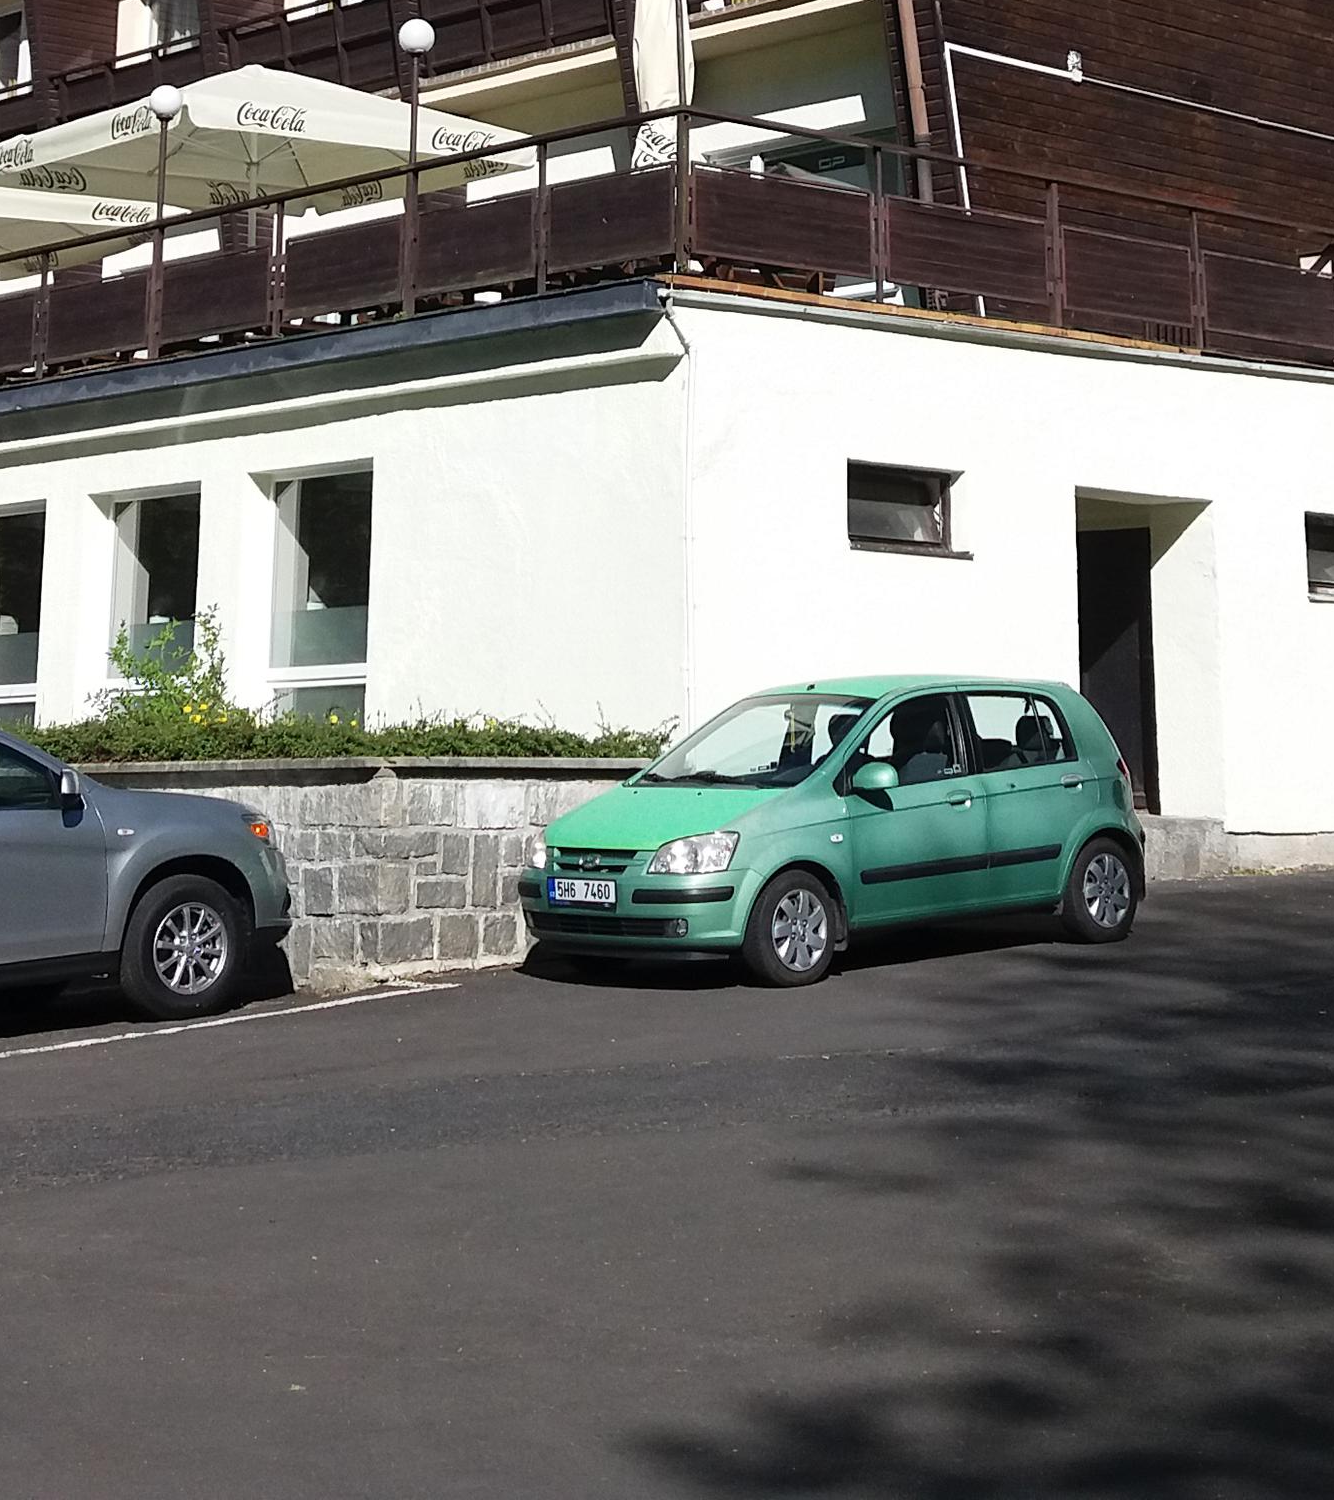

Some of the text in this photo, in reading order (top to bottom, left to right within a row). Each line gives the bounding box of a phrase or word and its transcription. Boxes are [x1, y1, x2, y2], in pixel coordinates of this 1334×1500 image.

[236, 100, 306, 133] Coca-Cola
[92, 202, 152, 223] Coca-Cola
[556, 881, 611, 900] 5H6 7460
